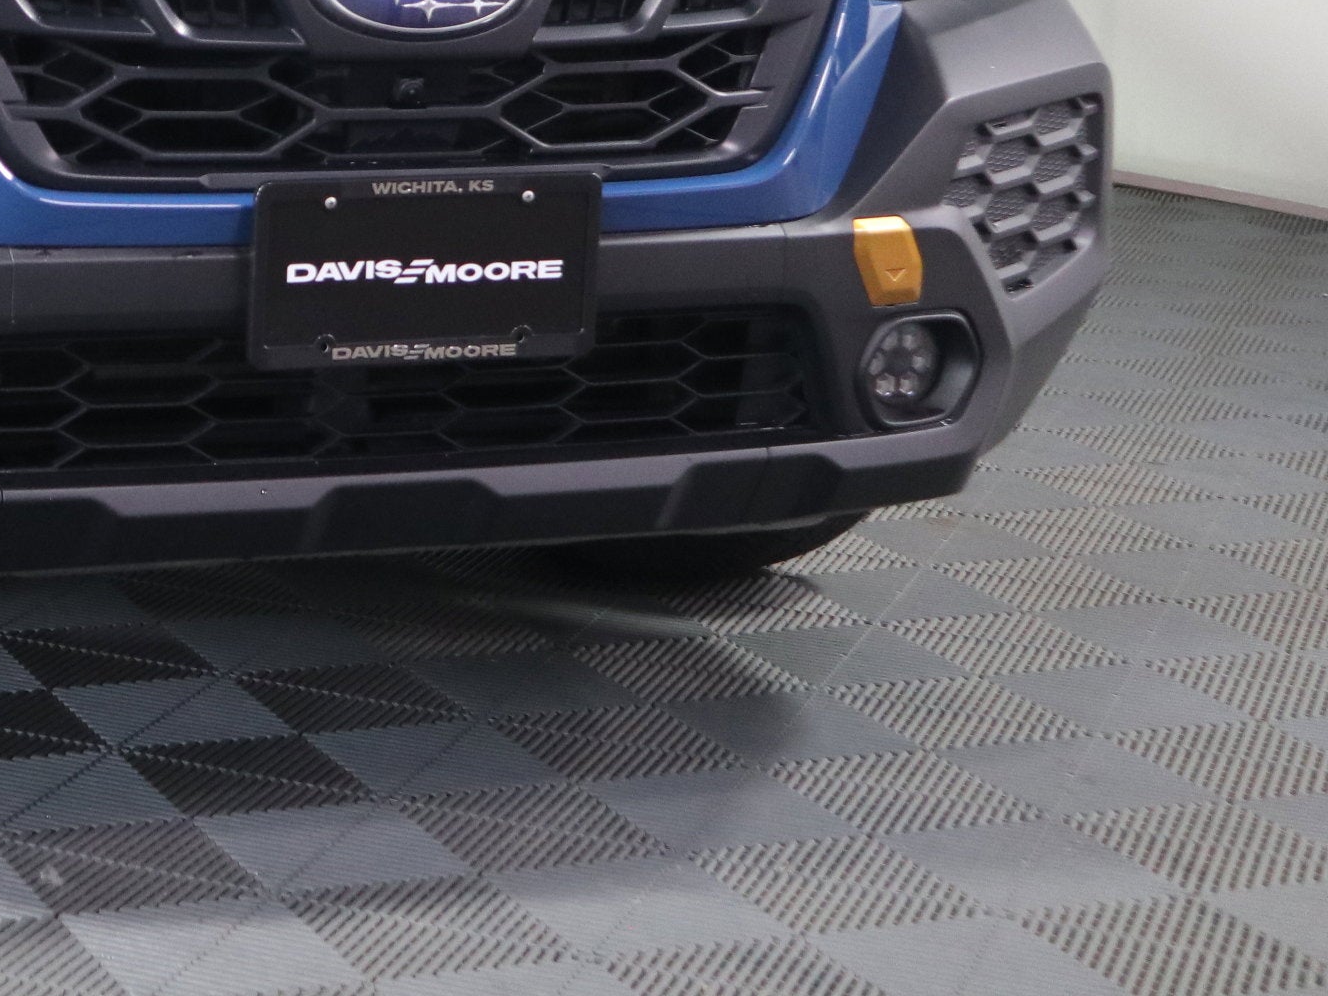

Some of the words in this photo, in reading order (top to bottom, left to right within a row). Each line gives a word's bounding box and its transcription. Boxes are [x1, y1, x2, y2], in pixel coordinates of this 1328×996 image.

[469, 179, 494, 192] KS
[286, 259, 401, 284] DAVIS
[425, 260, 564, 284] MOORE
[332, 345, 408, 361] DAVIS
[423, 343, 516, 360] MOORE
